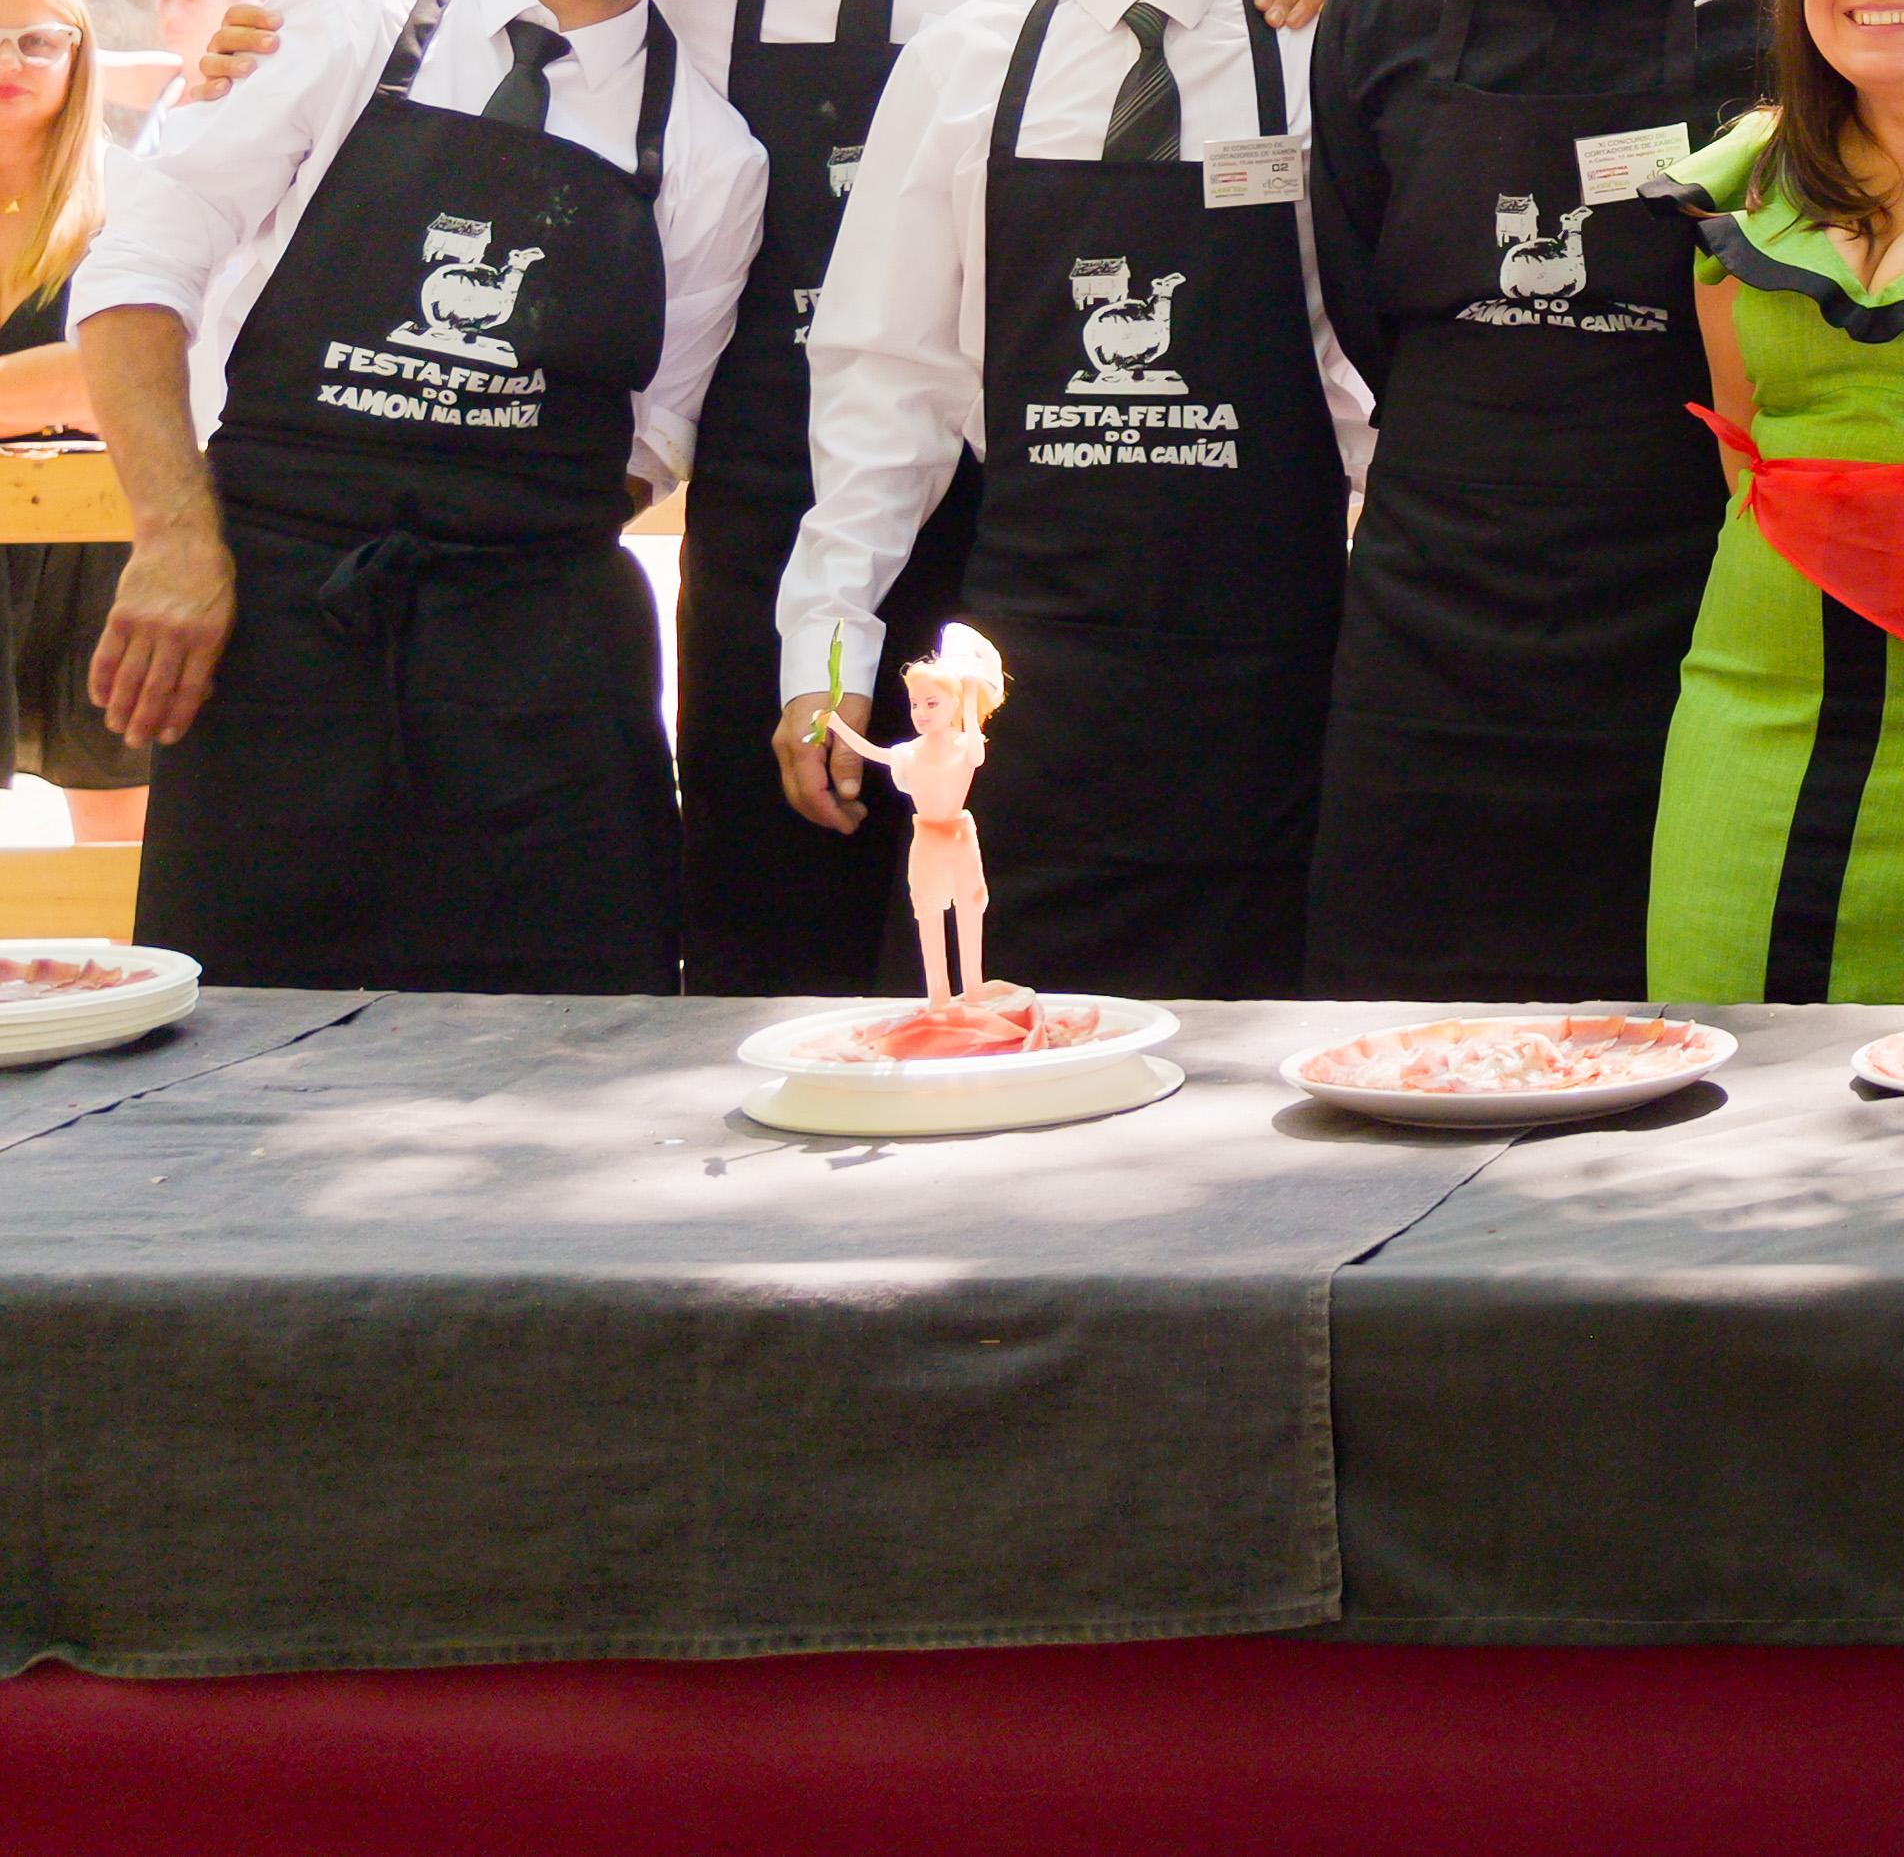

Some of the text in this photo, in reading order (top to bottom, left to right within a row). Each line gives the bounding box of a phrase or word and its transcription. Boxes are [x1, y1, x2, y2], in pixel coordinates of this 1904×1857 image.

[1271, 163, 1289, 172] 02
[1534, 298, 1570, 313] DO
[1547, 315, 1577, 328] NA
[324, 341, 547, 395] FESTA-FEIRA
[422, 387, 458, 406] DO
[431, 406, 462, 426] NA
[1025, 403, 1240, 431] FESTA-FEIRA
[1104, 428, 1141, 445] DO
[1116, 445, 1148, 464] NA
